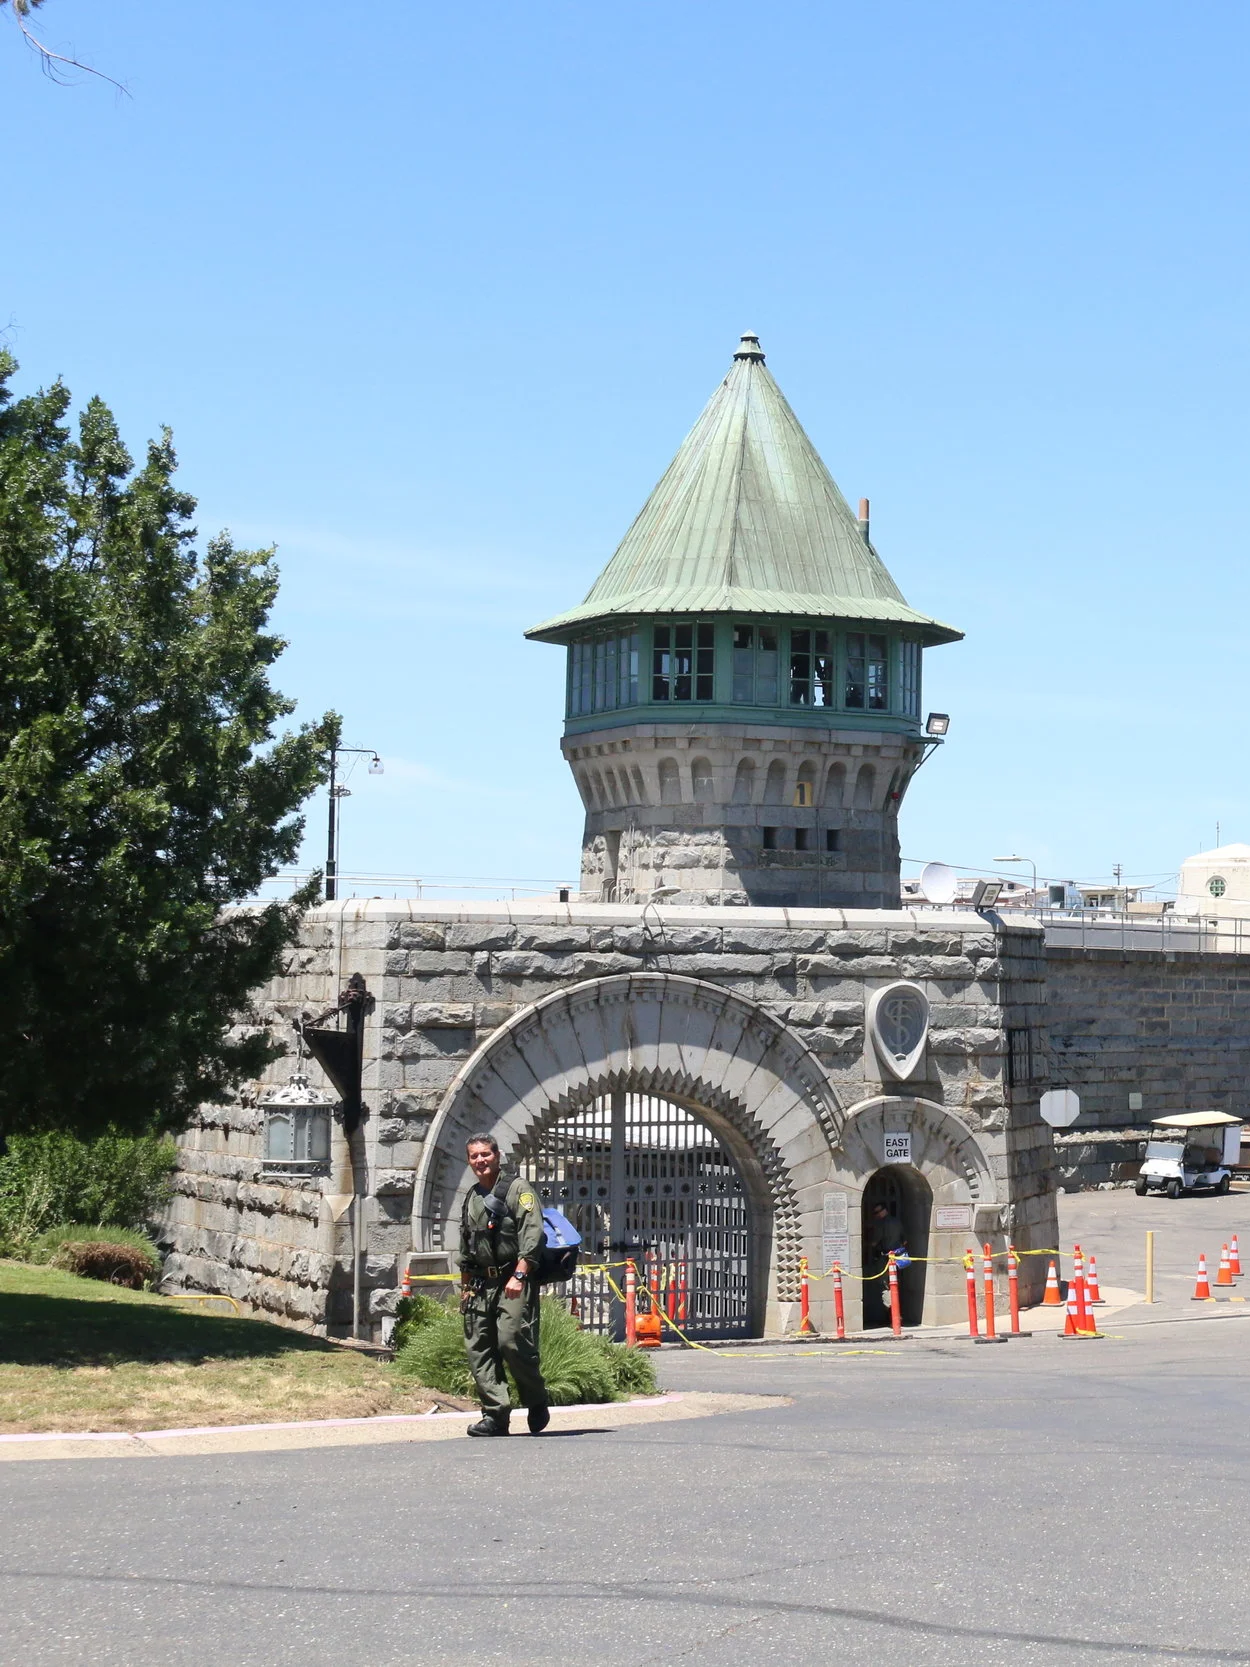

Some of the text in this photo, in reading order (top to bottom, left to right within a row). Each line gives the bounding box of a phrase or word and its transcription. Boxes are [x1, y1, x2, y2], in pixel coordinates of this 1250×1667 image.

[796, 783, 806, 805] 1
[885, 1138, 909, 1147] EAST
[886, 1149, 909, 1158] GATE
